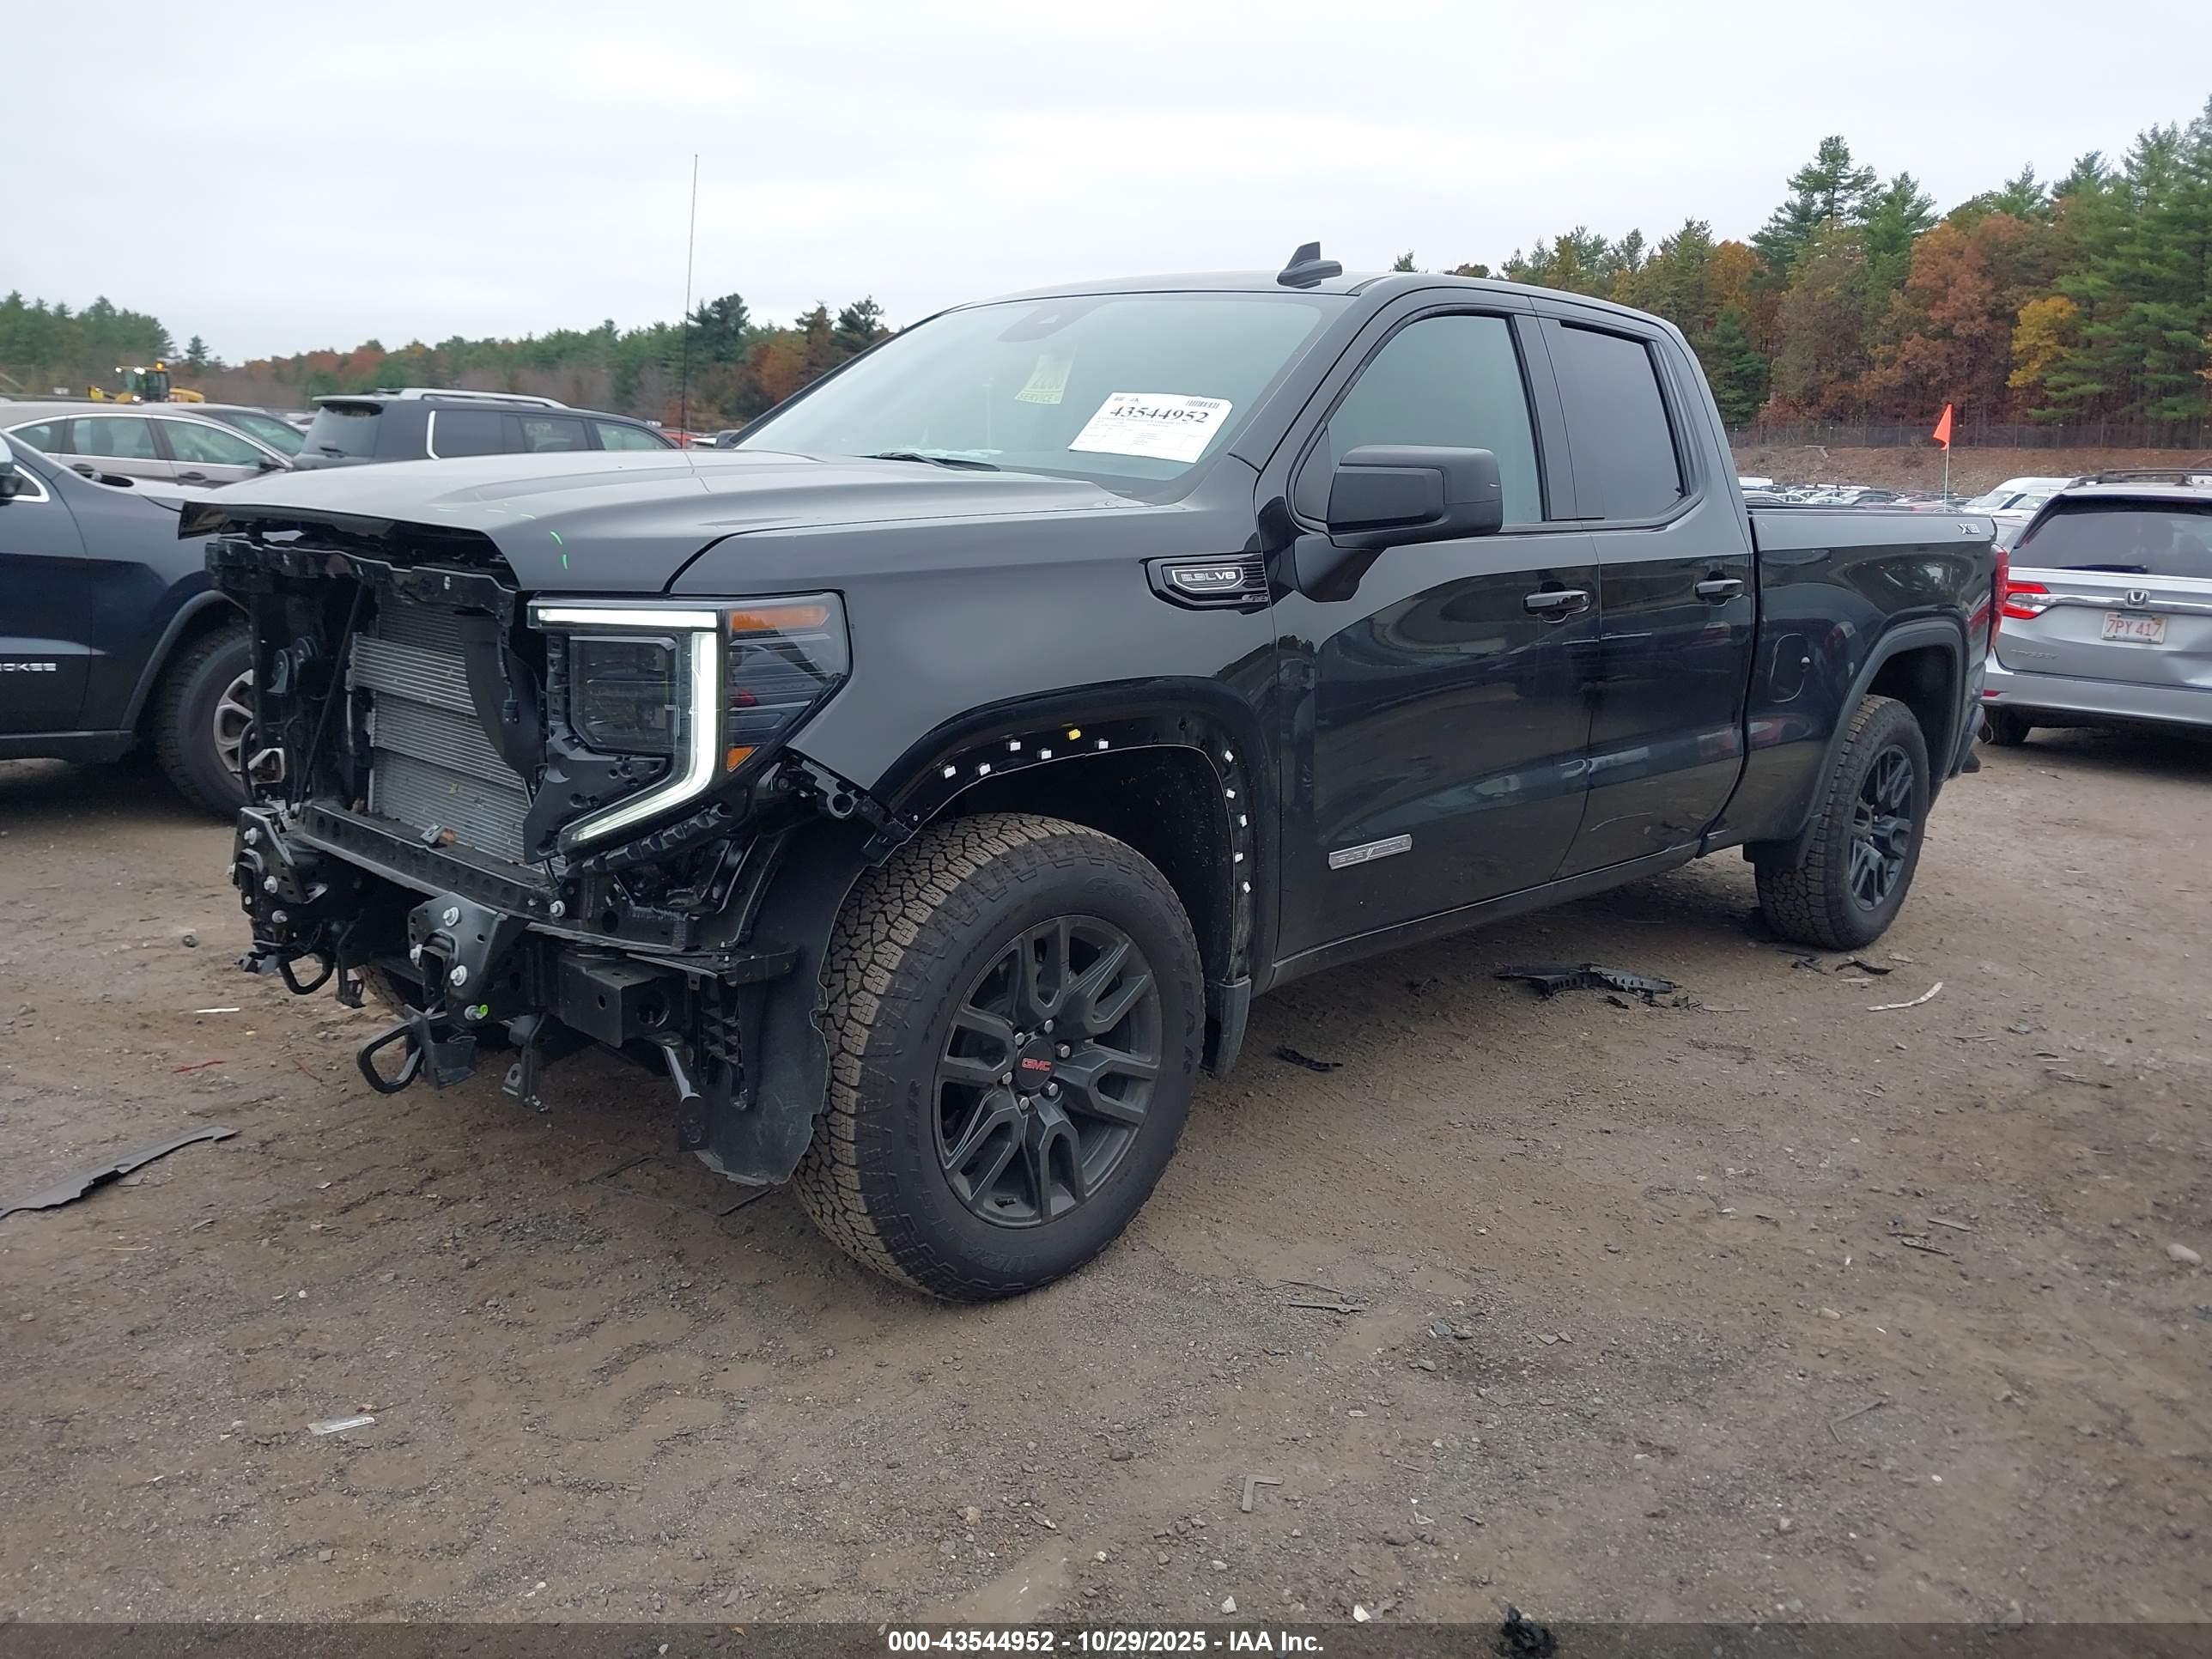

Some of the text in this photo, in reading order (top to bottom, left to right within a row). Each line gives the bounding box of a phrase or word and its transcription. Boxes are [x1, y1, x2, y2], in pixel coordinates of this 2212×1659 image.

[1109, 405, 1210, 423] 43544952
[2106, 618, 2162, 636] 7PY 417
[1021, 1057, 1052, 1073] GMC
